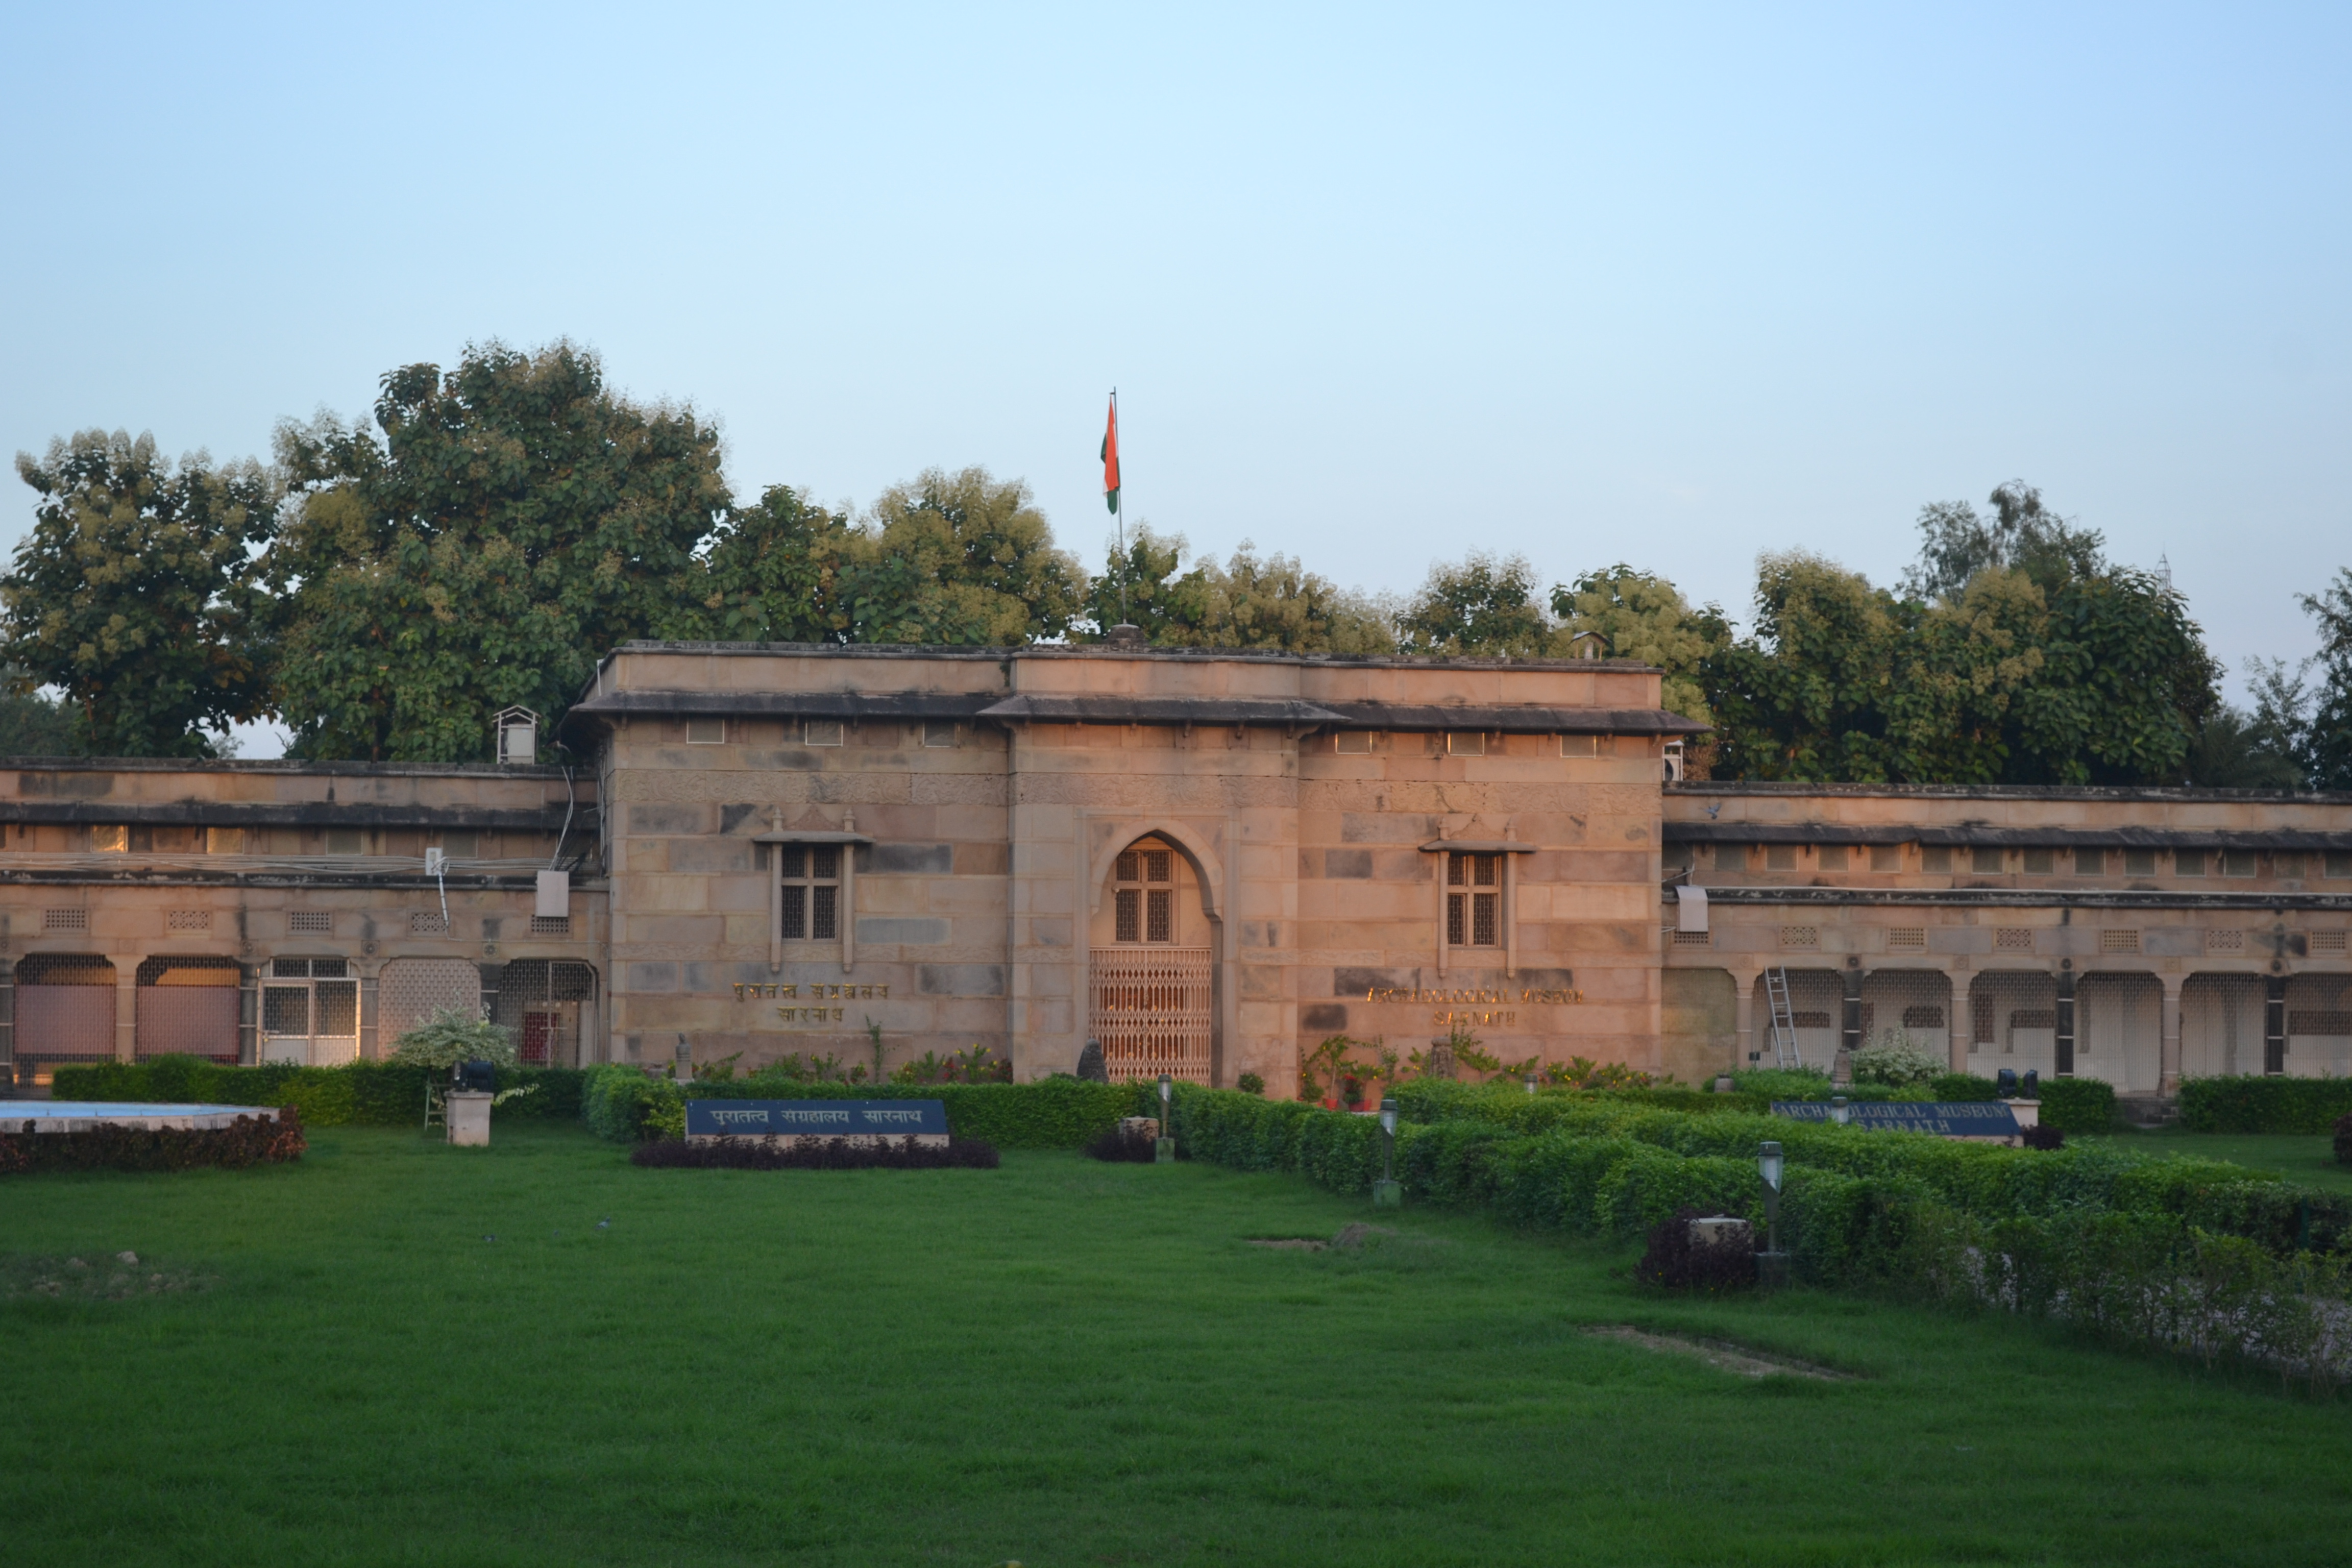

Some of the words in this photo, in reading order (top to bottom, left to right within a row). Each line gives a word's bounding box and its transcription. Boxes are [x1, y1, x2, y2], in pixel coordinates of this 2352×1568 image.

[1366, 987, 1514, 1004] ARCHAEOLOGICAL
[1520, 988, 1583, 1005] MUSEUM
[777, 1006, 844, 1022] सारनाथ
[1433, 1011, 1516, 1027] SARNATH
[780, 1109, 849, 1123] संग्रहालय
[862, 1110, 922, 1123] सारनाथ
[1934, 1105, 2009, 1118] MUSEUM
